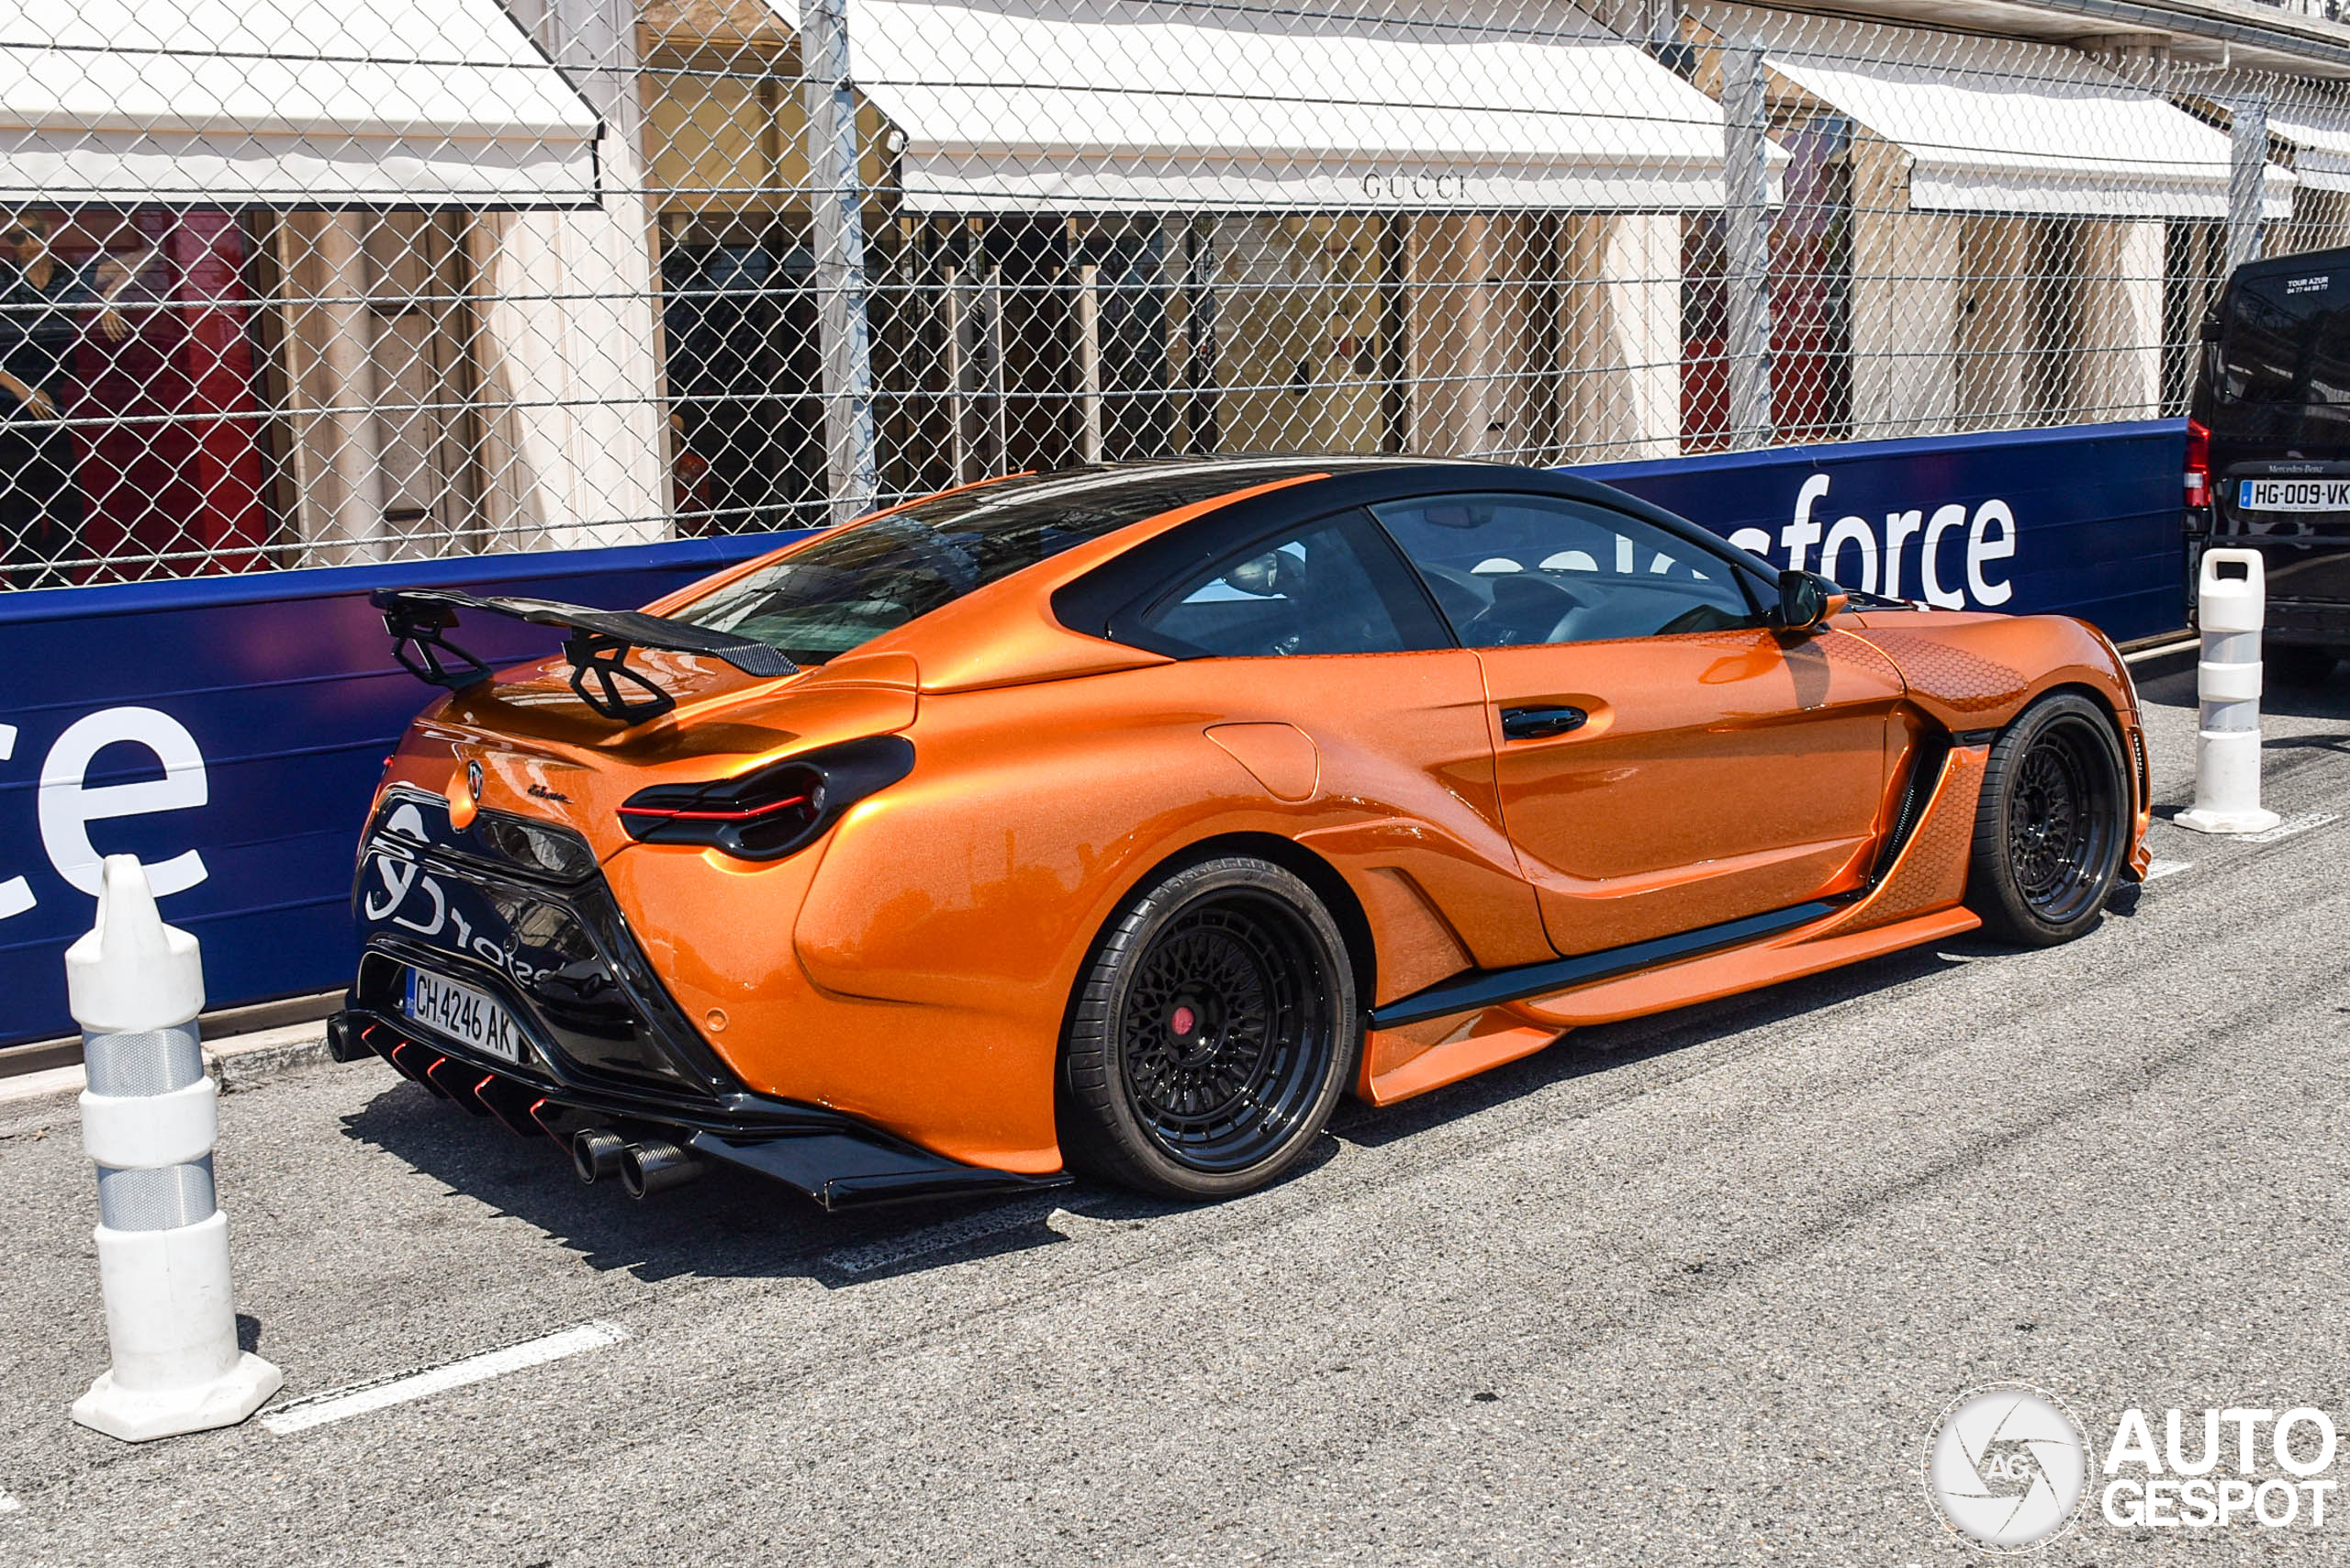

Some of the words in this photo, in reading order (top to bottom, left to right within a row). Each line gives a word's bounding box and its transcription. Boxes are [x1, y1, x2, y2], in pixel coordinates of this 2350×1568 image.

[1364, 173, 1464, 199] GUCCI
[2288, 278, 2308, 287] TOUR
[2309, 276, 2329, 285] AZUR
[2269, 465, 2323, 473] Mercedes-Benz
[2255, 484, 2350, 505] HG-009-VK
[441, 987, 482, 1041] 4246
[486, 1005, 512, 1055] AK
